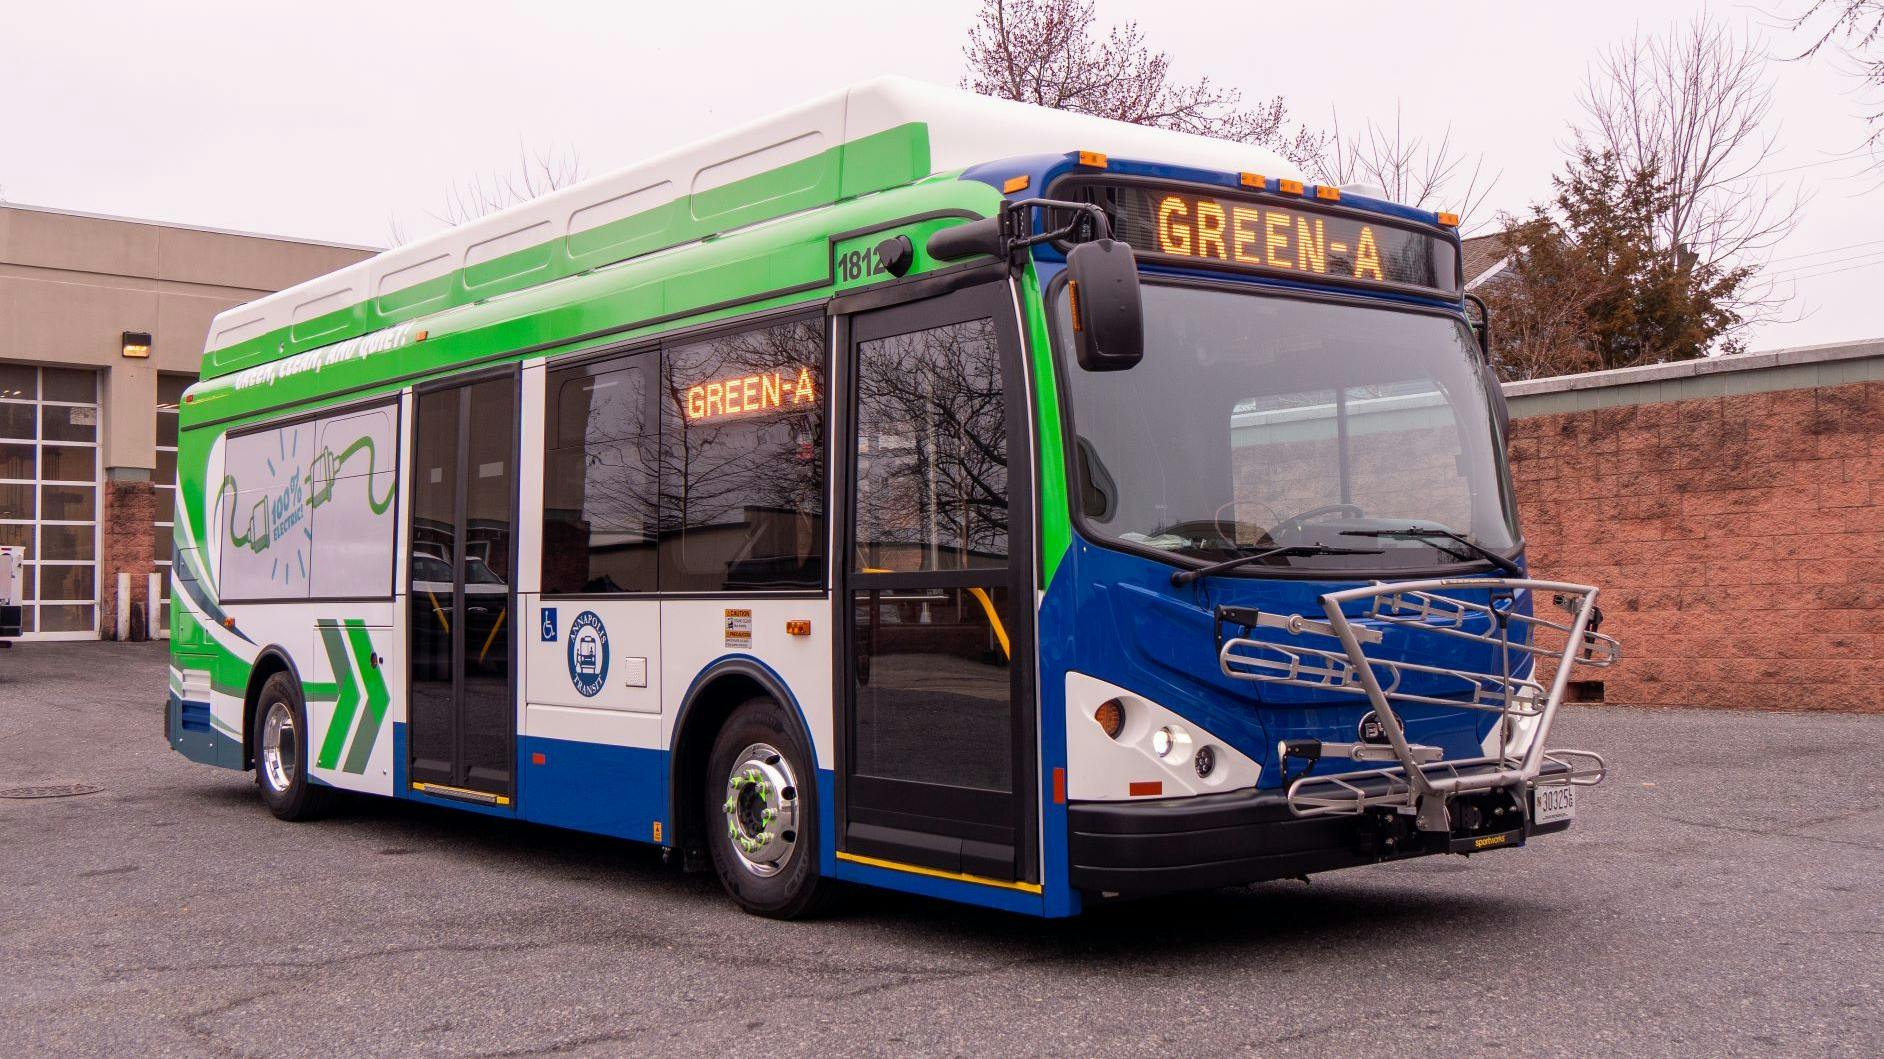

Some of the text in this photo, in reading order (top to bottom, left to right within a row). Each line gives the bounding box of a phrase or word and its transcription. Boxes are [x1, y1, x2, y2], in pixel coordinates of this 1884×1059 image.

[1158, 196, 1383, 281] GREEN-A
[687, 366, 815, 419] GREEN-A
[272, 466, 302, 525] 100%
[570, 614, 607, 645] ANNAPOLIS
[573, 673, 603, 696] TRANSIT
[1543, 788, 1569, 812] 30325
[1475, 835, 1506, 848] sportworks
